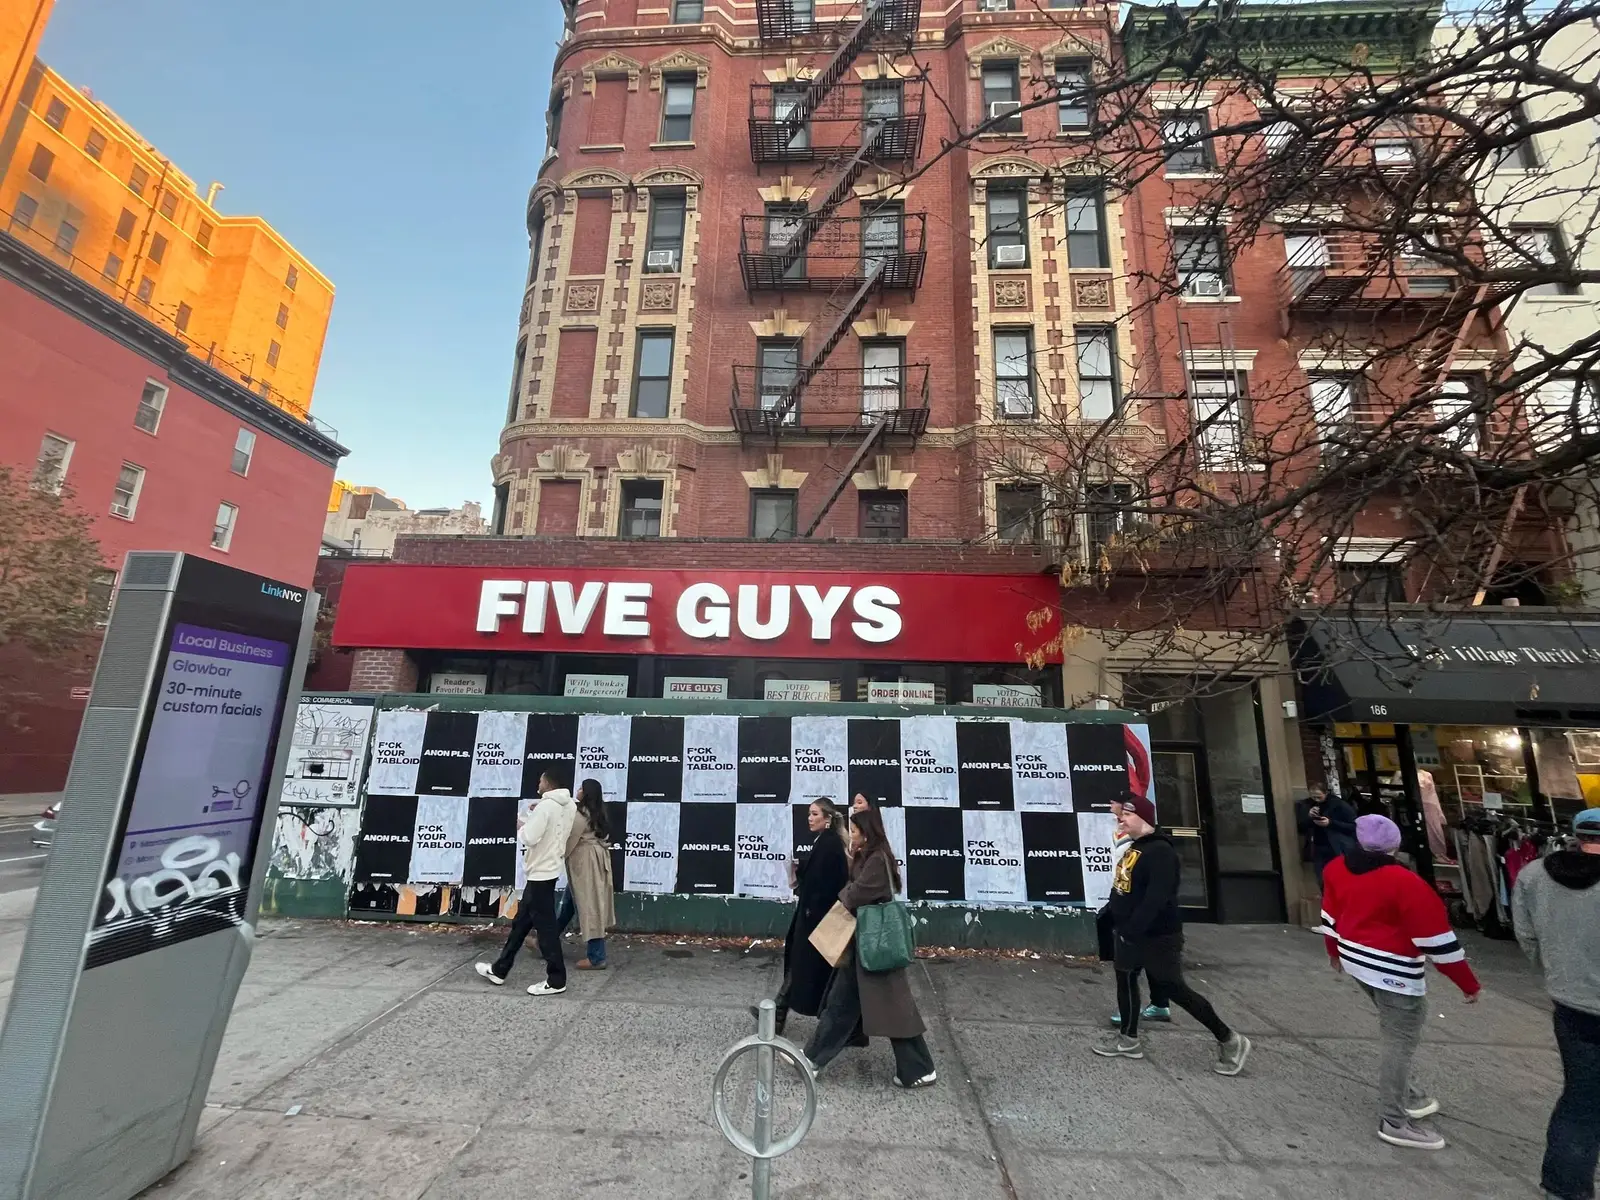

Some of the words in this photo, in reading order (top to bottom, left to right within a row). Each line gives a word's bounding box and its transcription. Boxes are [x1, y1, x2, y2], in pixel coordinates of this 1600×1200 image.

[261, 583, 303, 603] LinkNYC
[475, 579, 653, 636] FIVE
[676, 582, 902, 644] GUYS
[178, 632, 217, 649] Local
[218, 639, 274, 659] Business
[1451, 645, 1521, 666] Village
[1518, 647, 1585, 664] Thrift
[172, 659, 232, 677] Glowbar
[443, 678, 476, 686] Reader's
[166, 681, 242, 700] 30-minute
[435, 686, 464, 694] Favorite
[466, 686, 483, 694] Pick
[567, 687, 576, 695] of
[671, 683, 692, 691] FIVE
[694, 684, 721, 692] GUYS
[766, 690, 788, 700] BEST
[791, 691, 830, 701] BURGER
[871, 688, 899, 698] ORDER
[902, 689, 933, 699] ONLINE
[996, 689, 1020, 697] VOTED
[976, 697, 996, 705] BEST
[163, 701, 218, 714] custom
[221, 703, 262, 717] facials
[1370, 705, 1387, 715] 186
[451, 750, 471, 758] PLS.
[579, 762, 627, 770] TABLOID.
[687, 763, 736, 771] TABLOID.
[905, 766, 956, 774] TABLOID.
[1016, 763, 1047, 771] YOUR
[1016, 771, 1069, 779] TABLOID.
[363, 834, 389, 842] ANON
[390, 835, 410, 843] PLS.
[625, 841, 655, 849] YOUR
[738, 844, 769, 852] YOUR
[625, 850, 674, 859] TABLOID.
[910, 849, 938, 857] ANON
[969, 849, 1000, 857] YOUR
[1027, 850, 1057, 858] ANON
[969, 857, 1021, 867] TABLOID.
[1085, 855, 1113, 863] YOU
